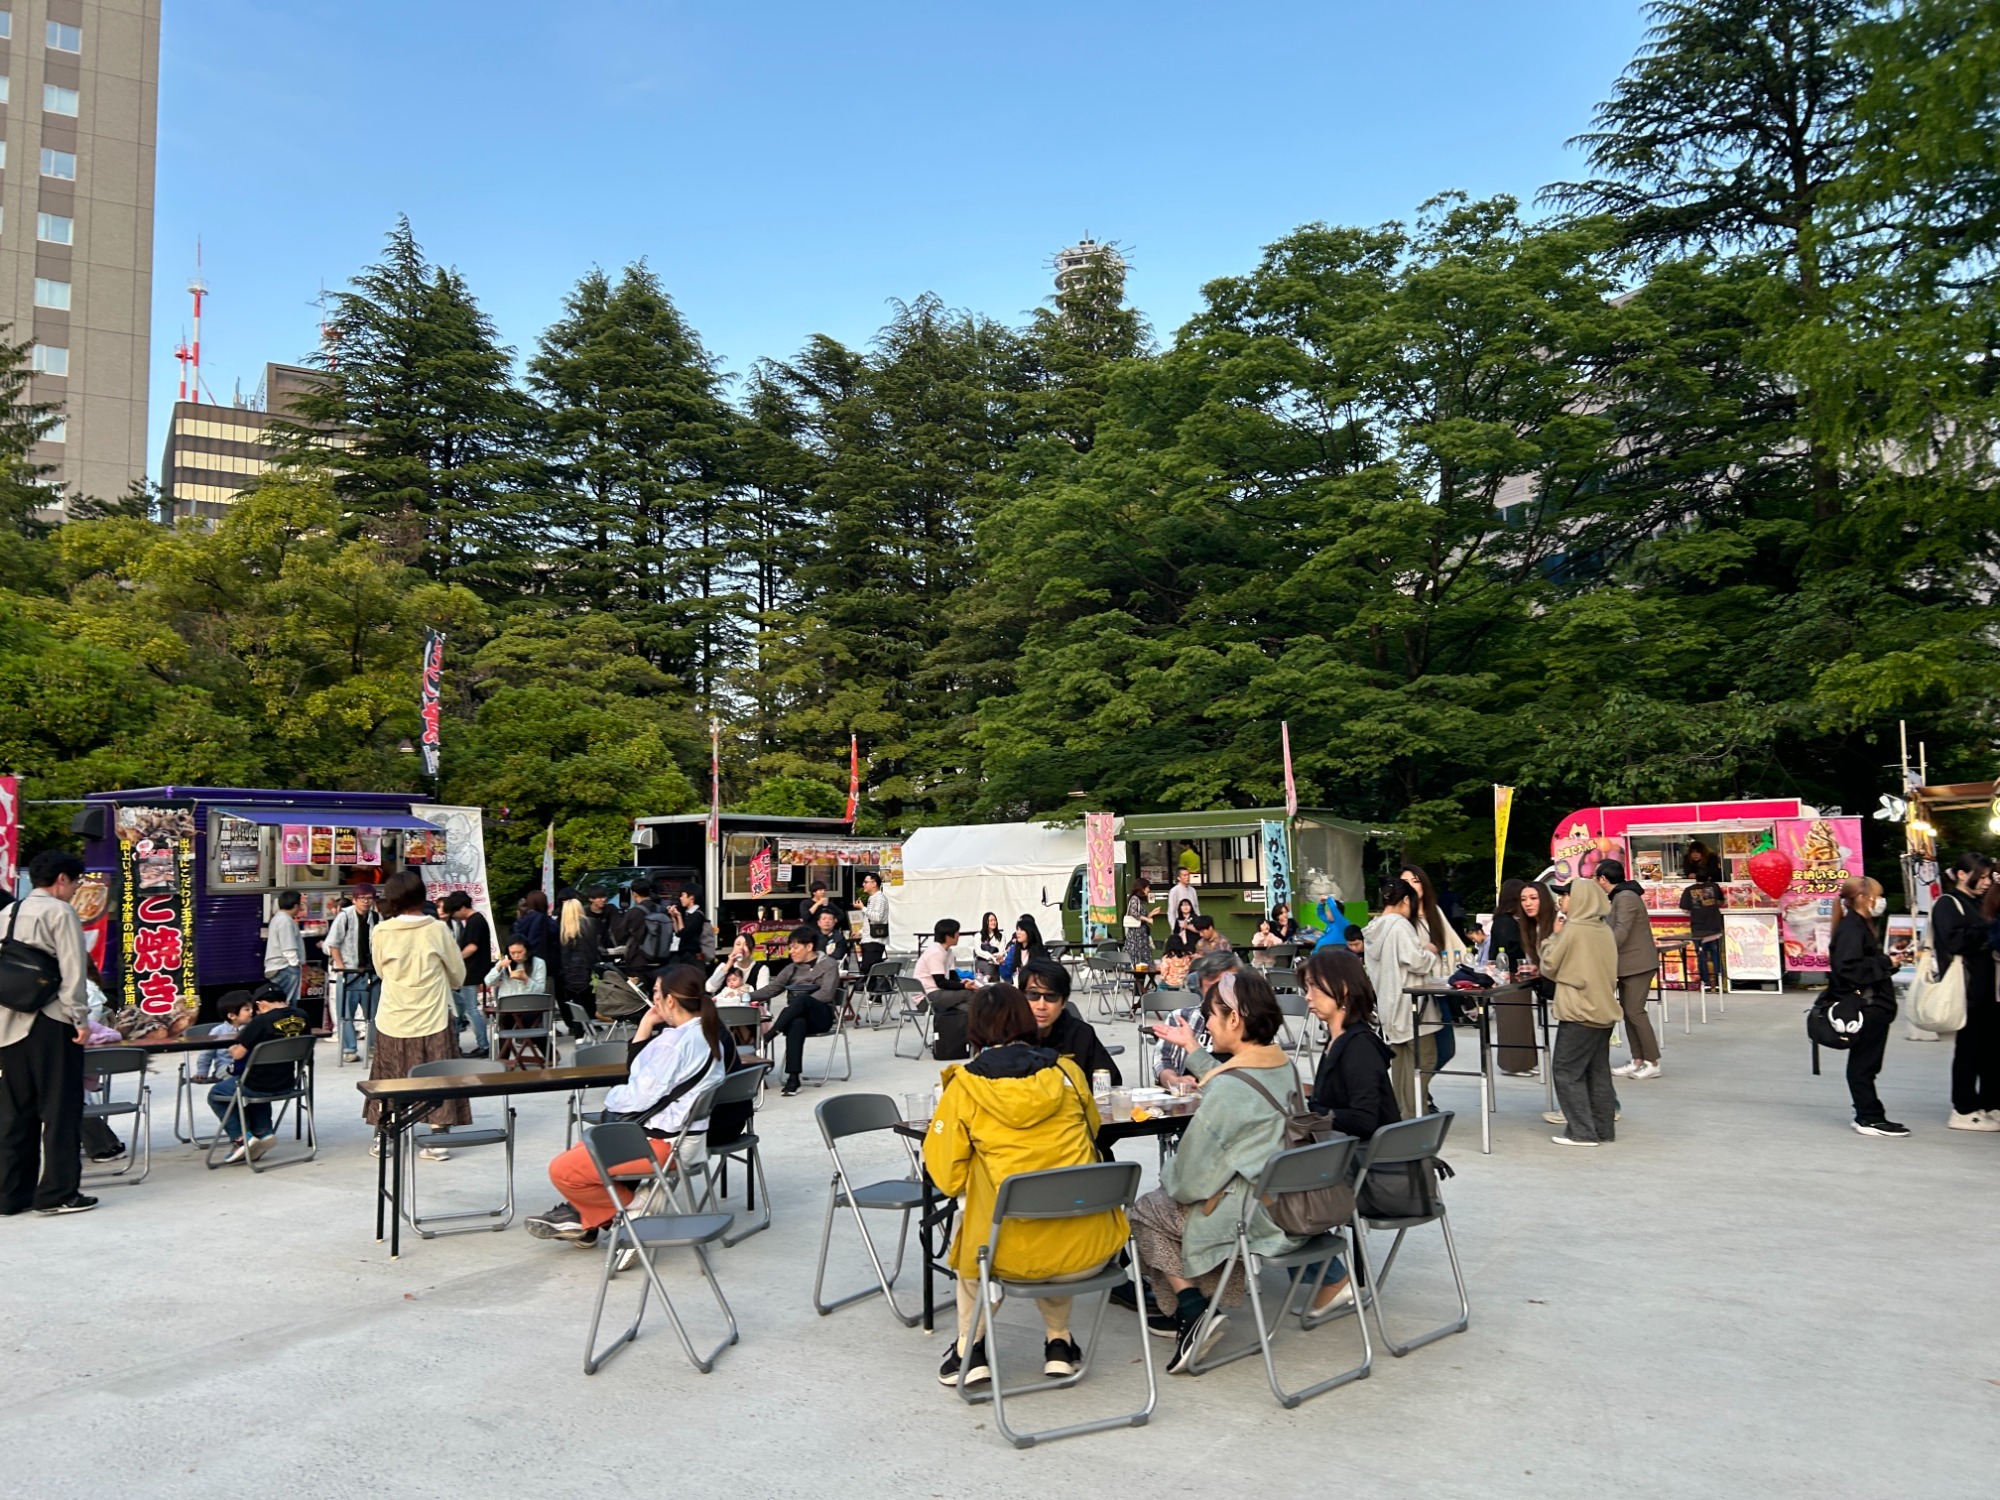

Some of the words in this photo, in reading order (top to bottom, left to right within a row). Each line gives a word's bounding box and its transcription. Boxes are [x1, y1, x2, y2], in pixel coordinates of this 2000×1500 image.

[431, 854, 446, 863] 600
[1268, 836, 1287, 905] からあげ
[1792, 869, 1849, 881] 安納いもの
[133, 893, 183, 1015] こ焼き
[307, 986, 324, 996] 600
